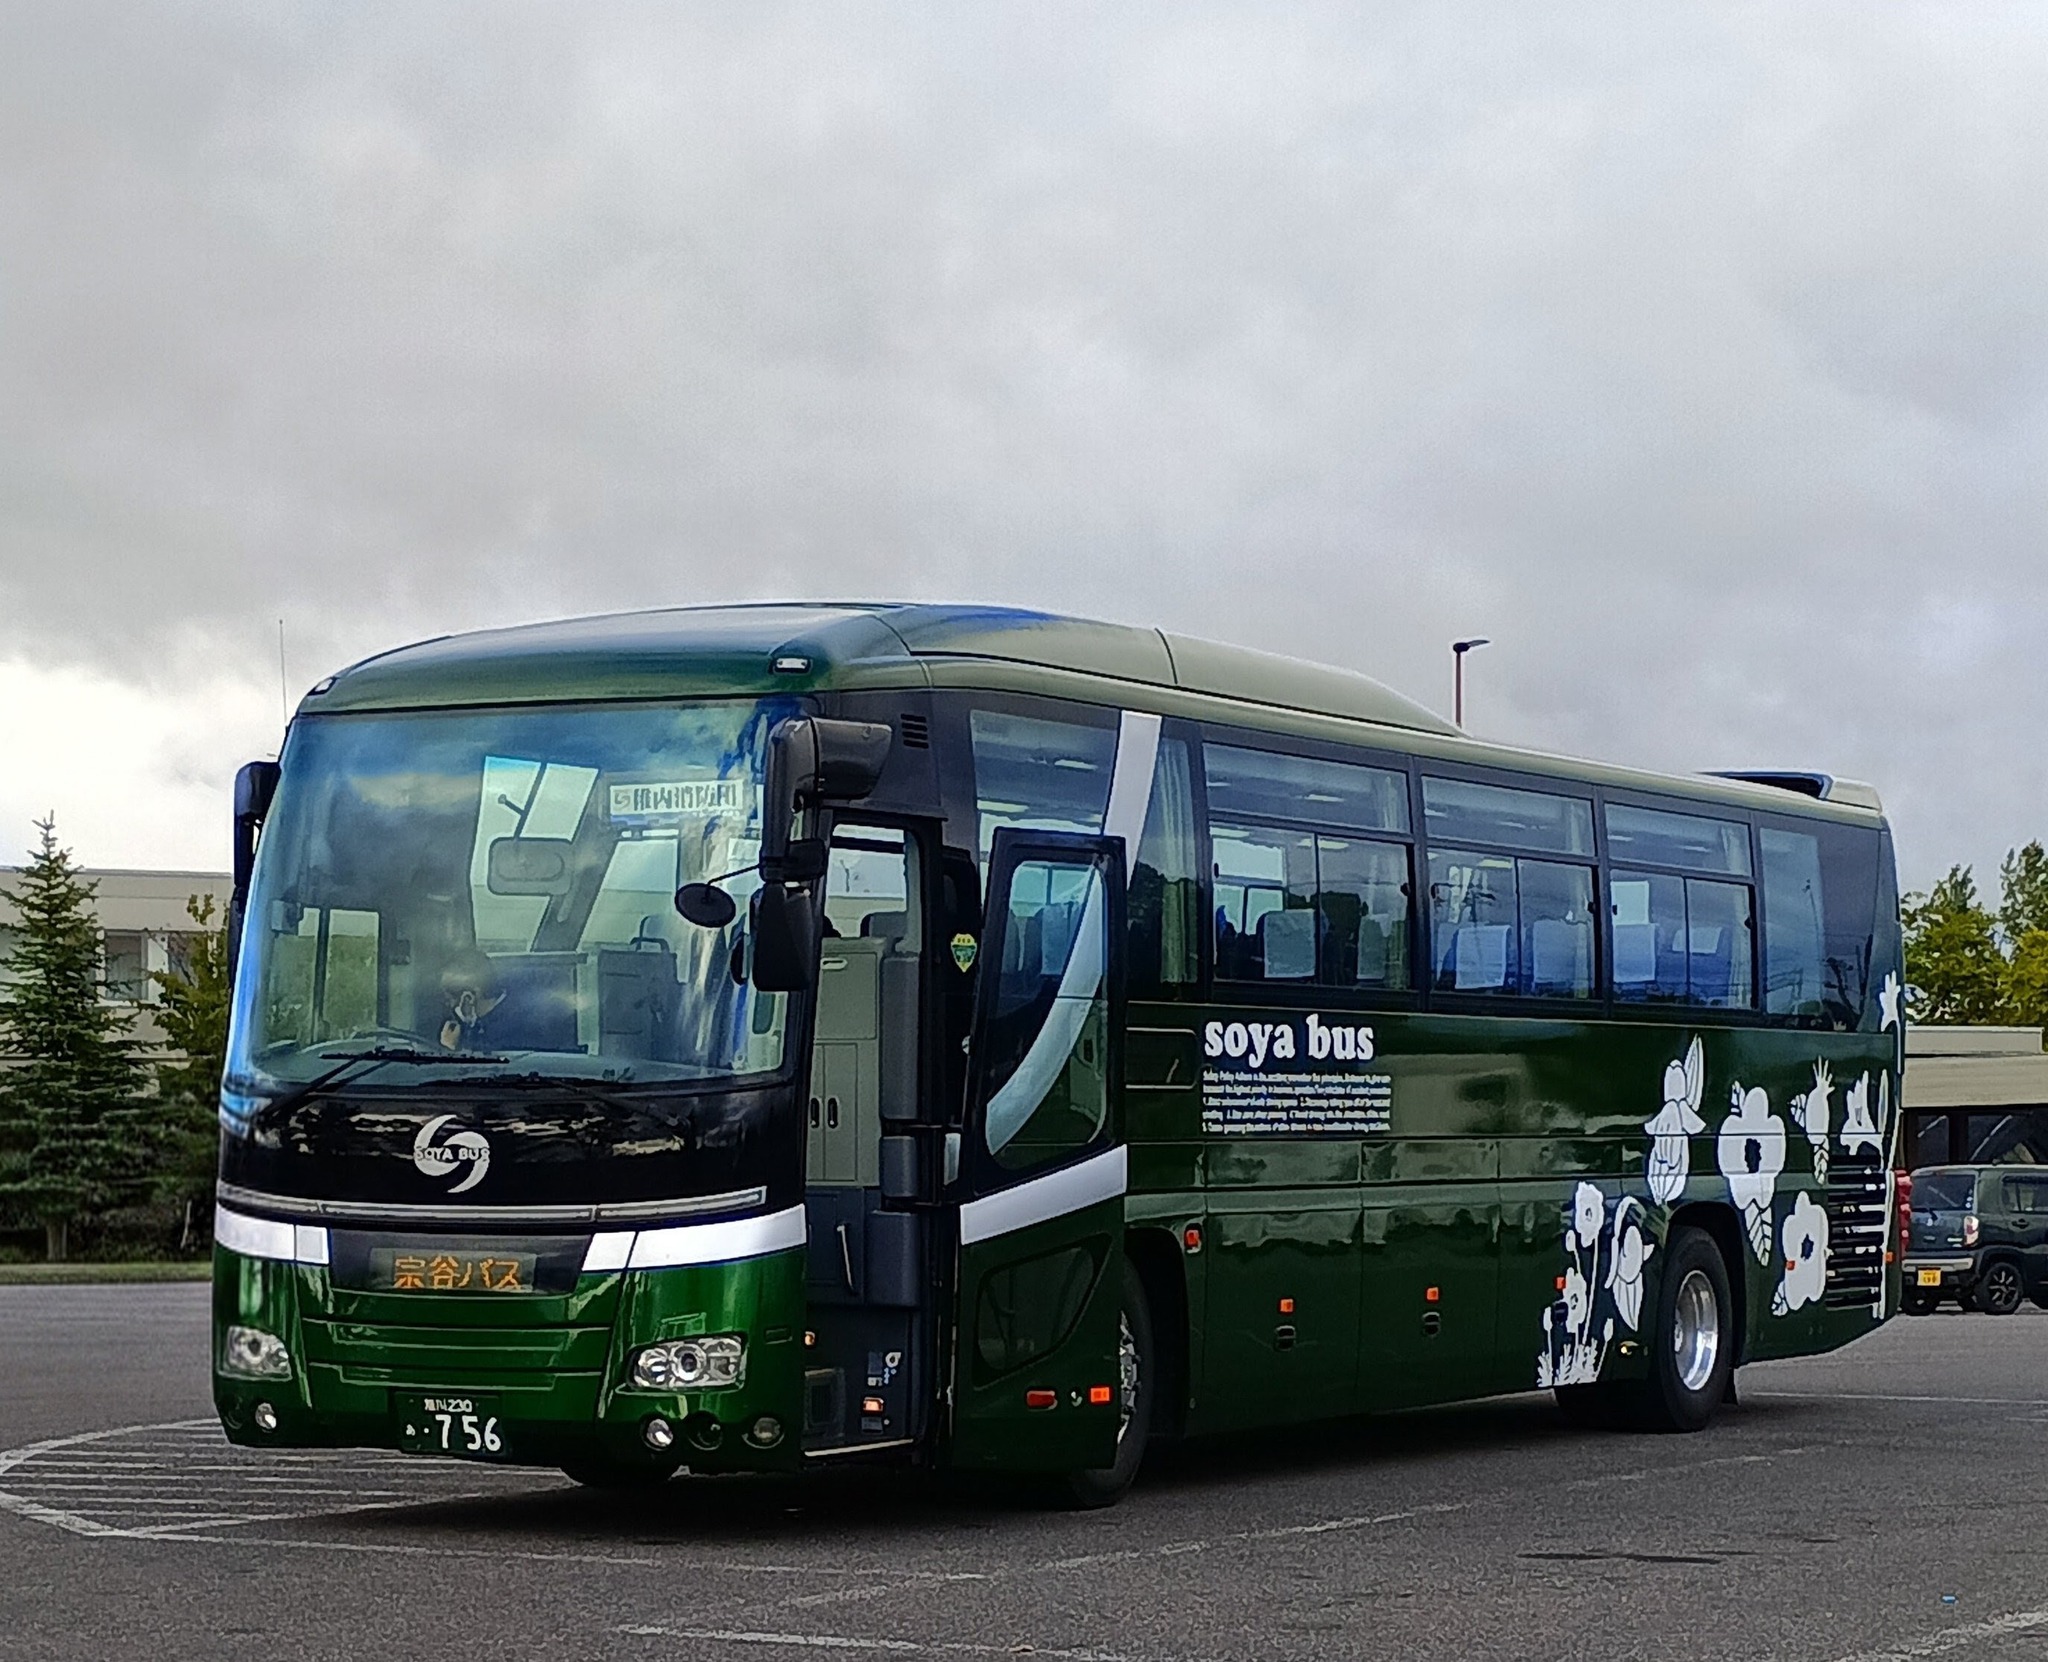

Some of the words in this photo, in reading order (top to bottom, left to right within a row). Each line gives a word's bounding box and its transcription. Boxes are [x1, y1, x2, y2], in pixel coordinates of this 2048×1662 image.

[1204, 1021, 1296, 1068] soya
[1306, 1013, 1374, 1060] bus
[394, 1255, 522, 1290] 宗谷バス
